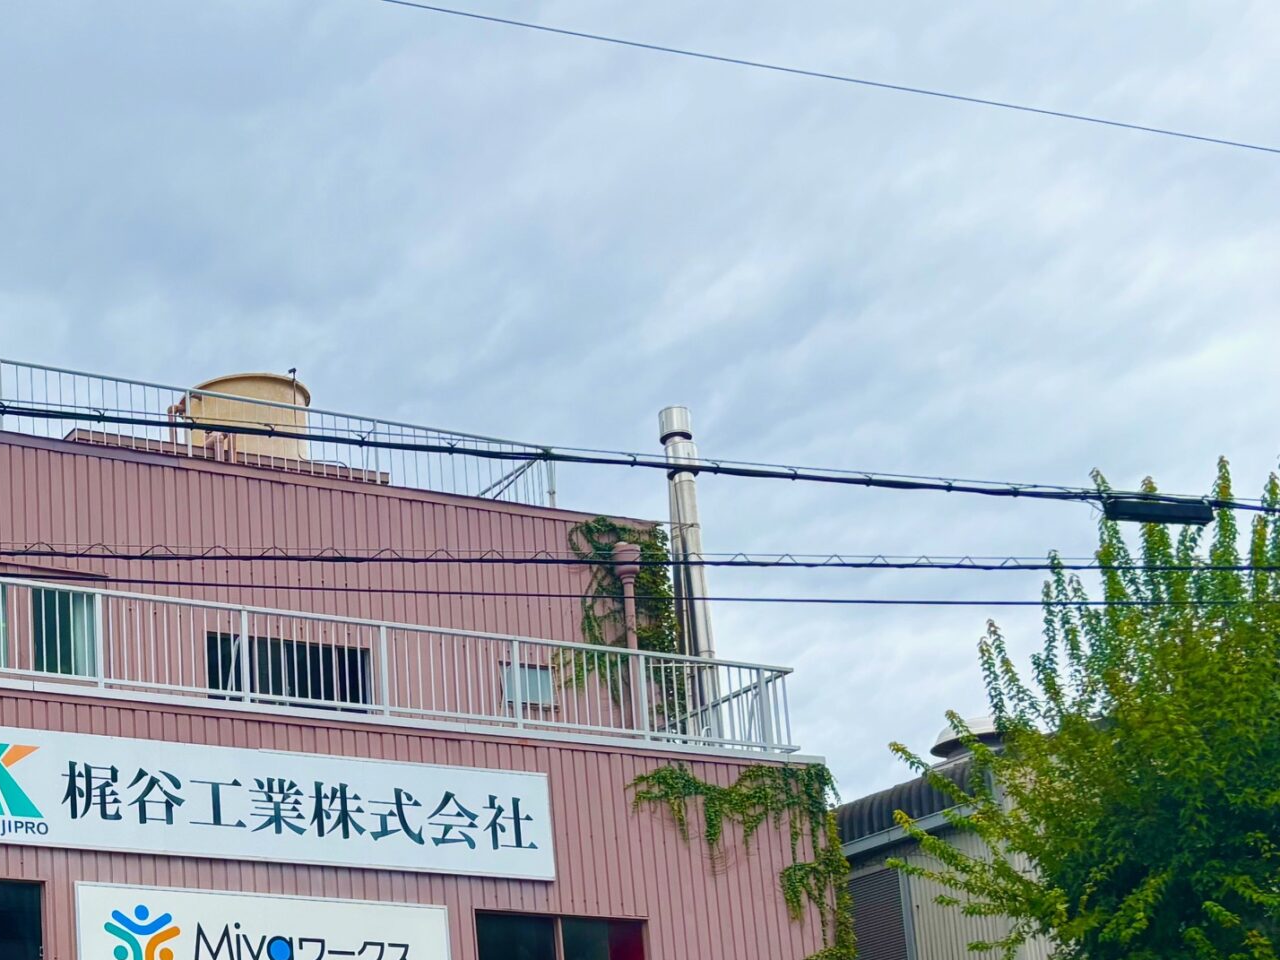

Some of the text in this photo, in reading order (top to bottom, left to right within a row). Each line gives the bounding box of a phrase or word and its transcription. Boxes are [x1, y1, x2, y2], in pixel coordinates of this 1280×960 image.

[61, 760, 538, 850] 梶谷工業株式会社
